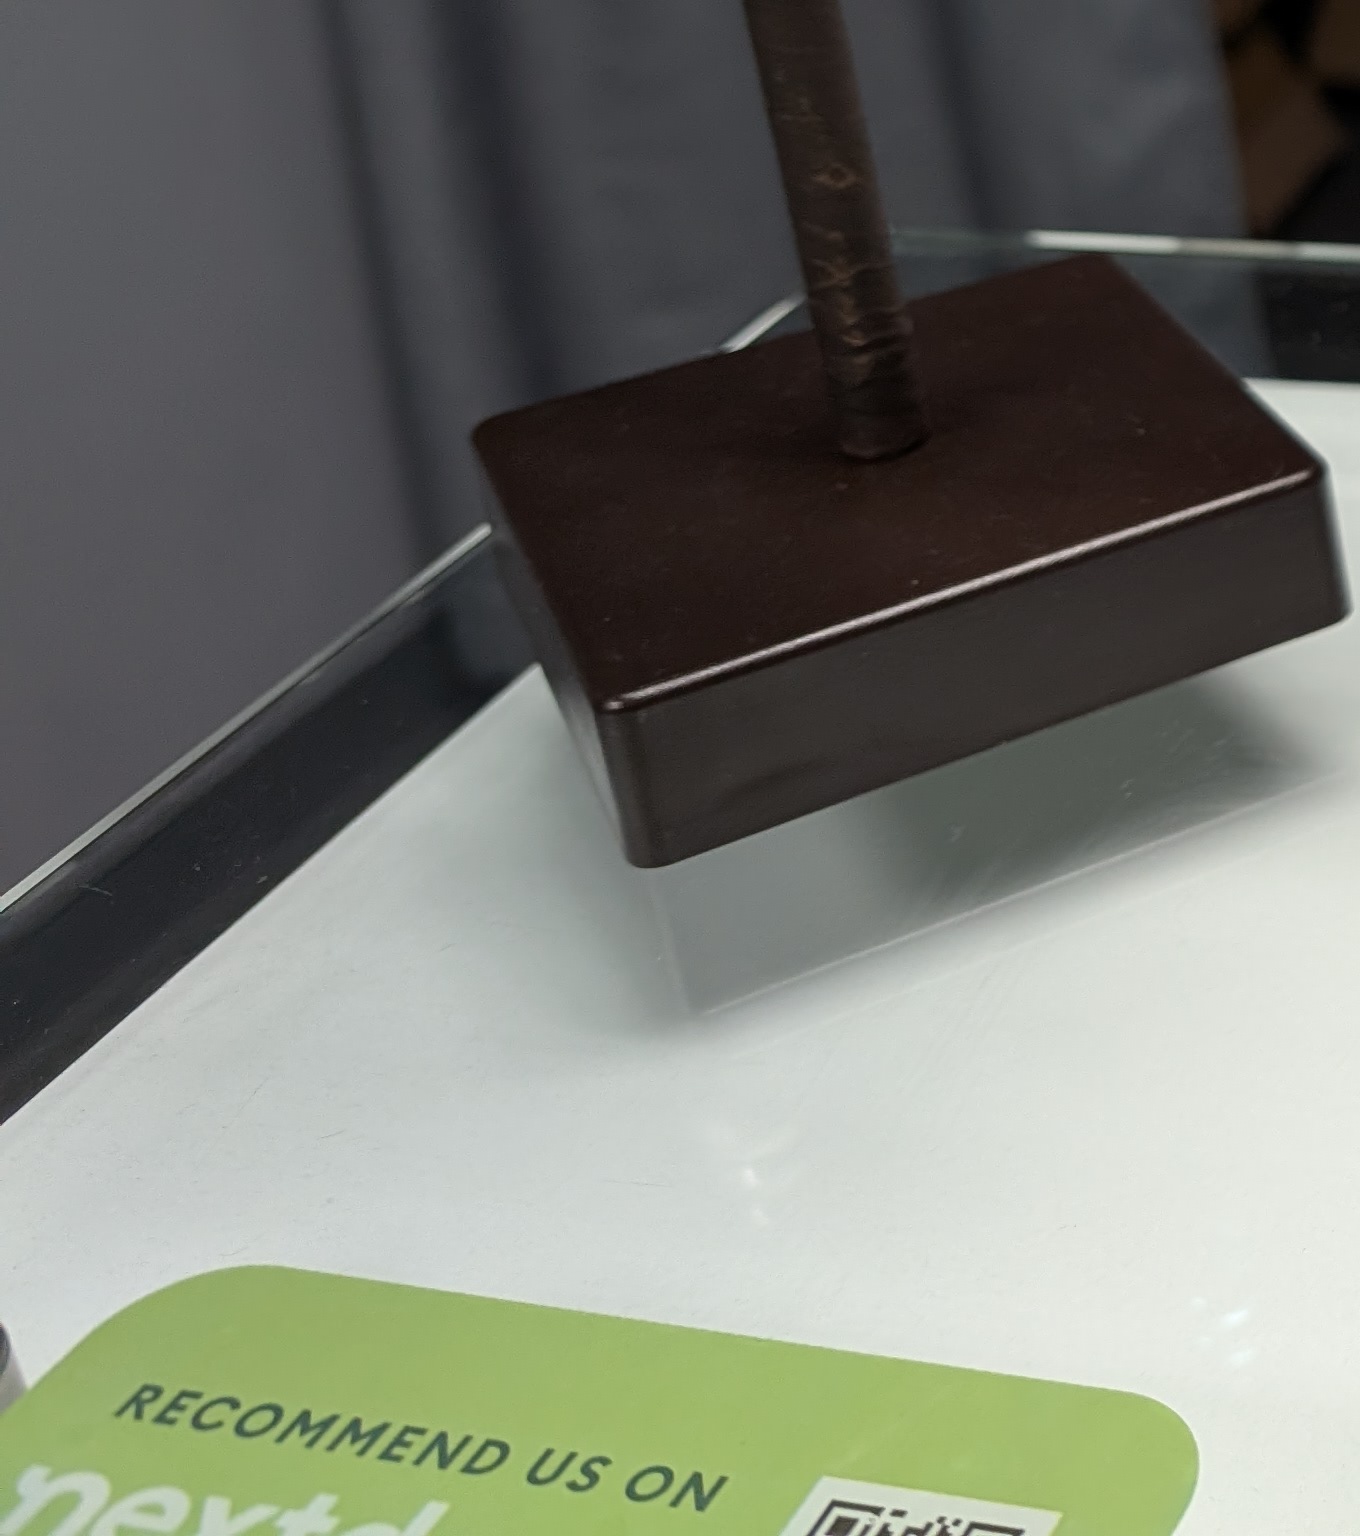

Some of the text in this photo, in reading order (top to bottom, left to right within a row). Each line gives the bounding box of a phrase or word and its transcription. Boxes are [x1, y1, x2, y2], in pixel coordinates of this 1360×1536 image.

[112, 1382, 730, 1513] RECOMMEND US ON
